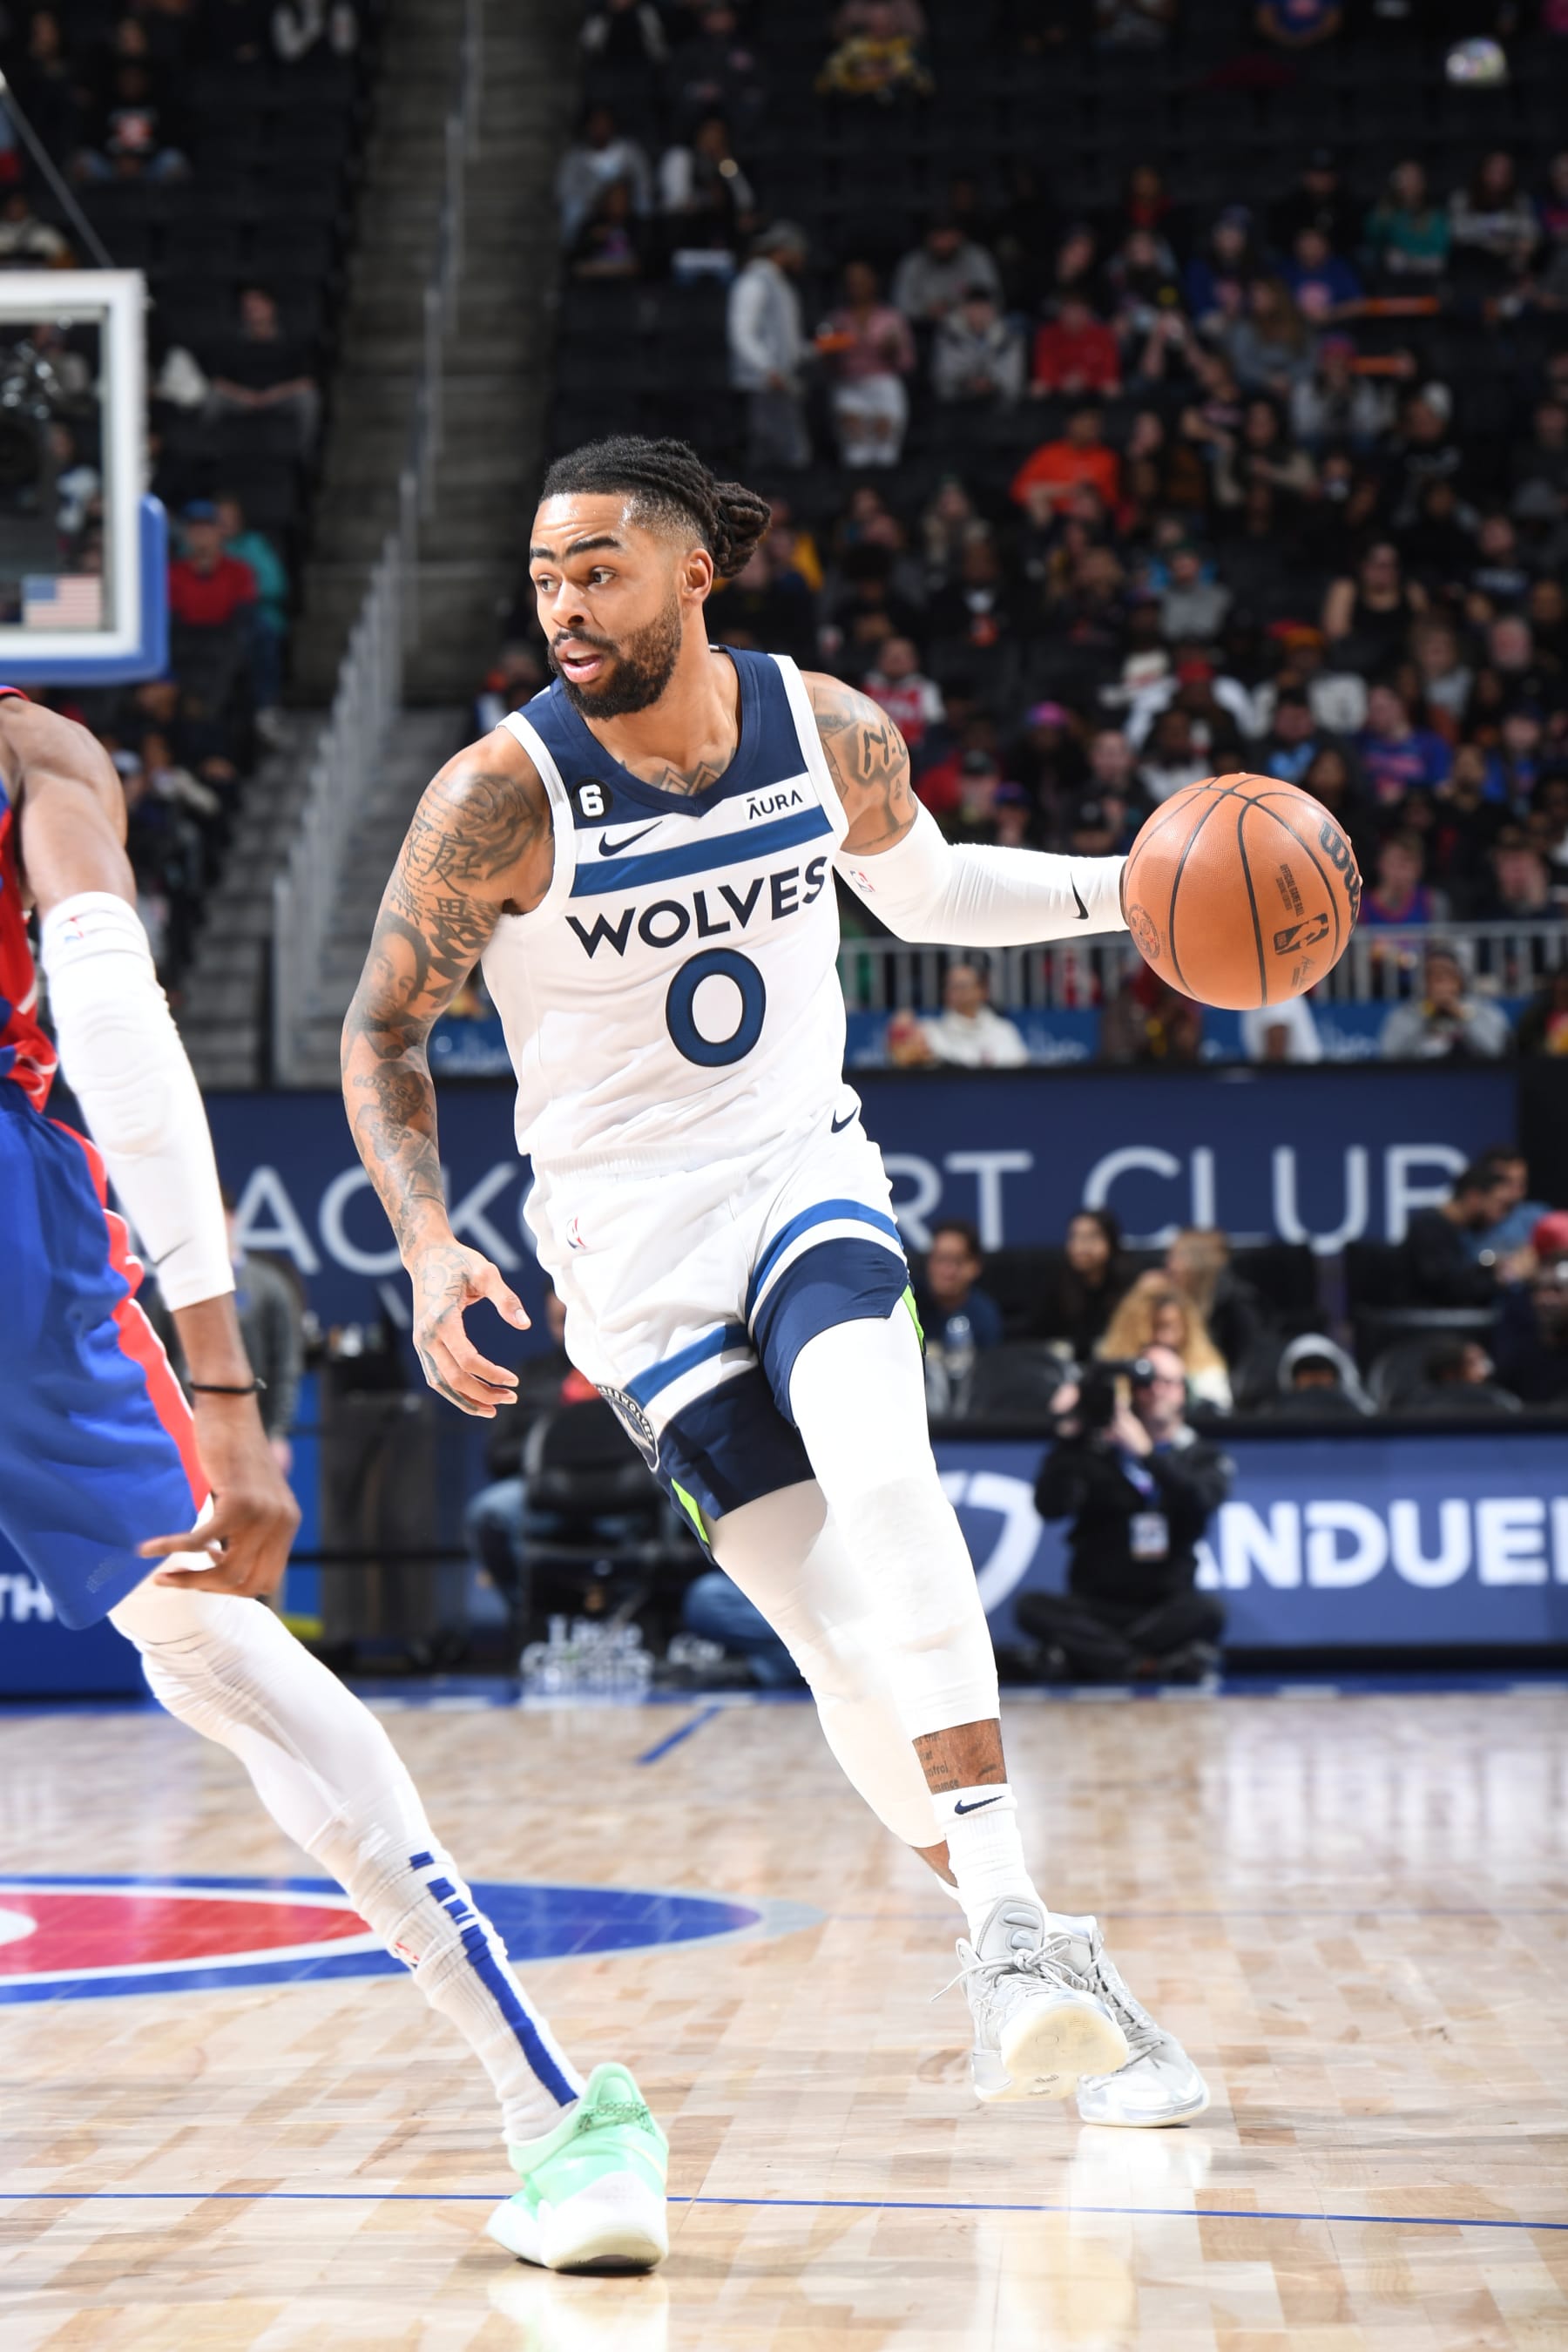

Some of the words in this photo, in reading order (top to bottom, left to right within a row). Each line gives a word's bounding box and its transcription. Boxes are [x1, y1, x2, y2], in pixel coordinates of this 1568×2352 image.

[578, 784, 605, 818] 6
[565, 856, 828, 959] WOLVES
[666, 947, 767, 1067] 0
[1193, 1497, 1568, 1591] NDUE
